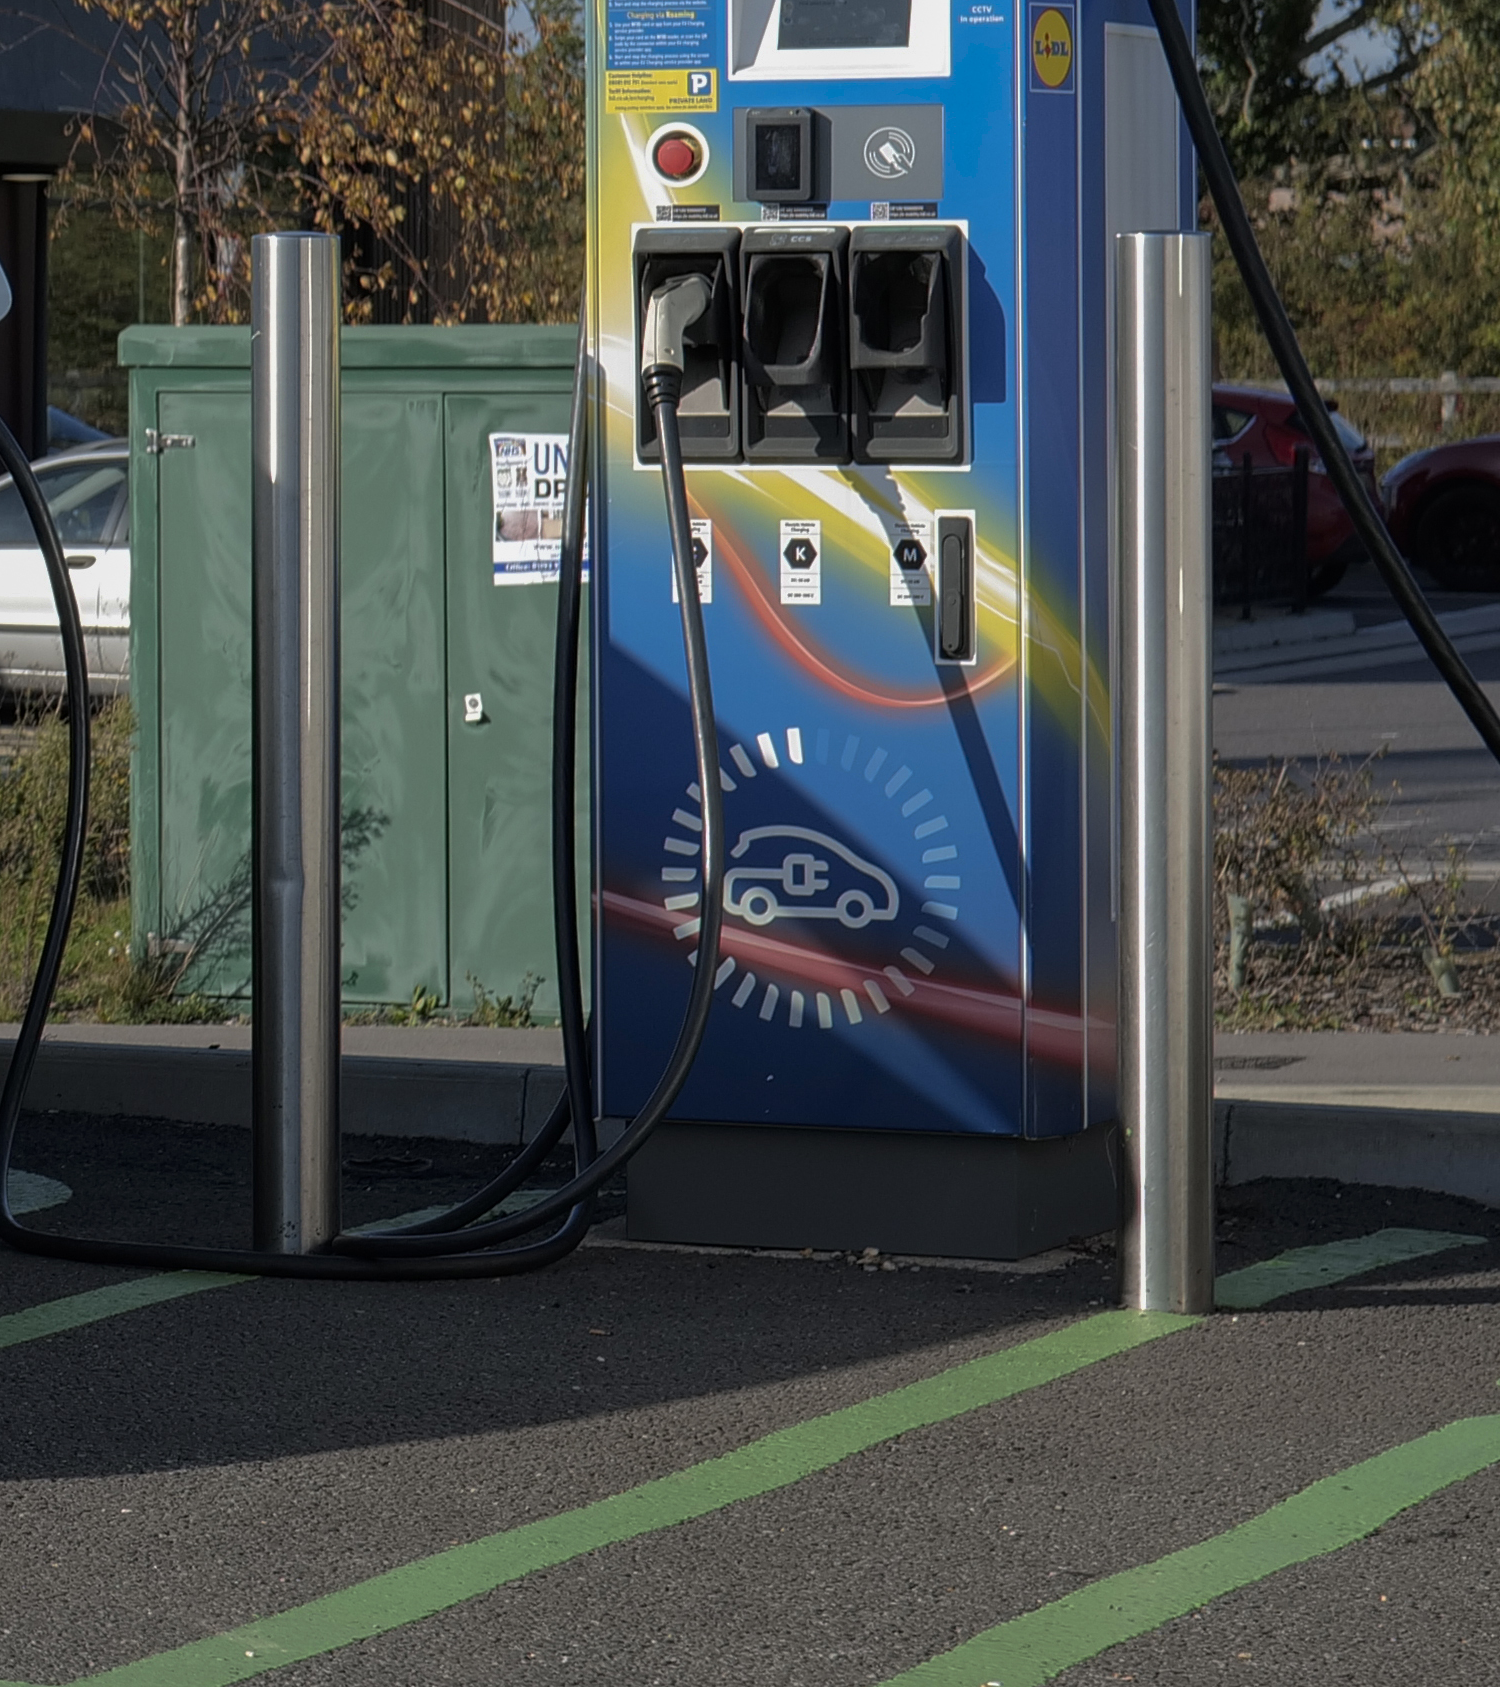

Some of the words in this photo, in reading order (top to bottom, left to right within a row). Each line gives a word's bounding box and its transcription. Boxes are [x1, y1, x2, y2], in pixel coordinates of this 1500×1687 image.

[972, 5, 992, 13] CCTV
[627, 11, 655, 20] Charging
[666, 10, 695, 20] Roaming
[969, 15, 1004, 24] operation
[696, 96, 713, 104] LAND
[790, 235, 812, 243] CCS
[796, 546, 806, 561] K
[903, 547, 917, 562] M
